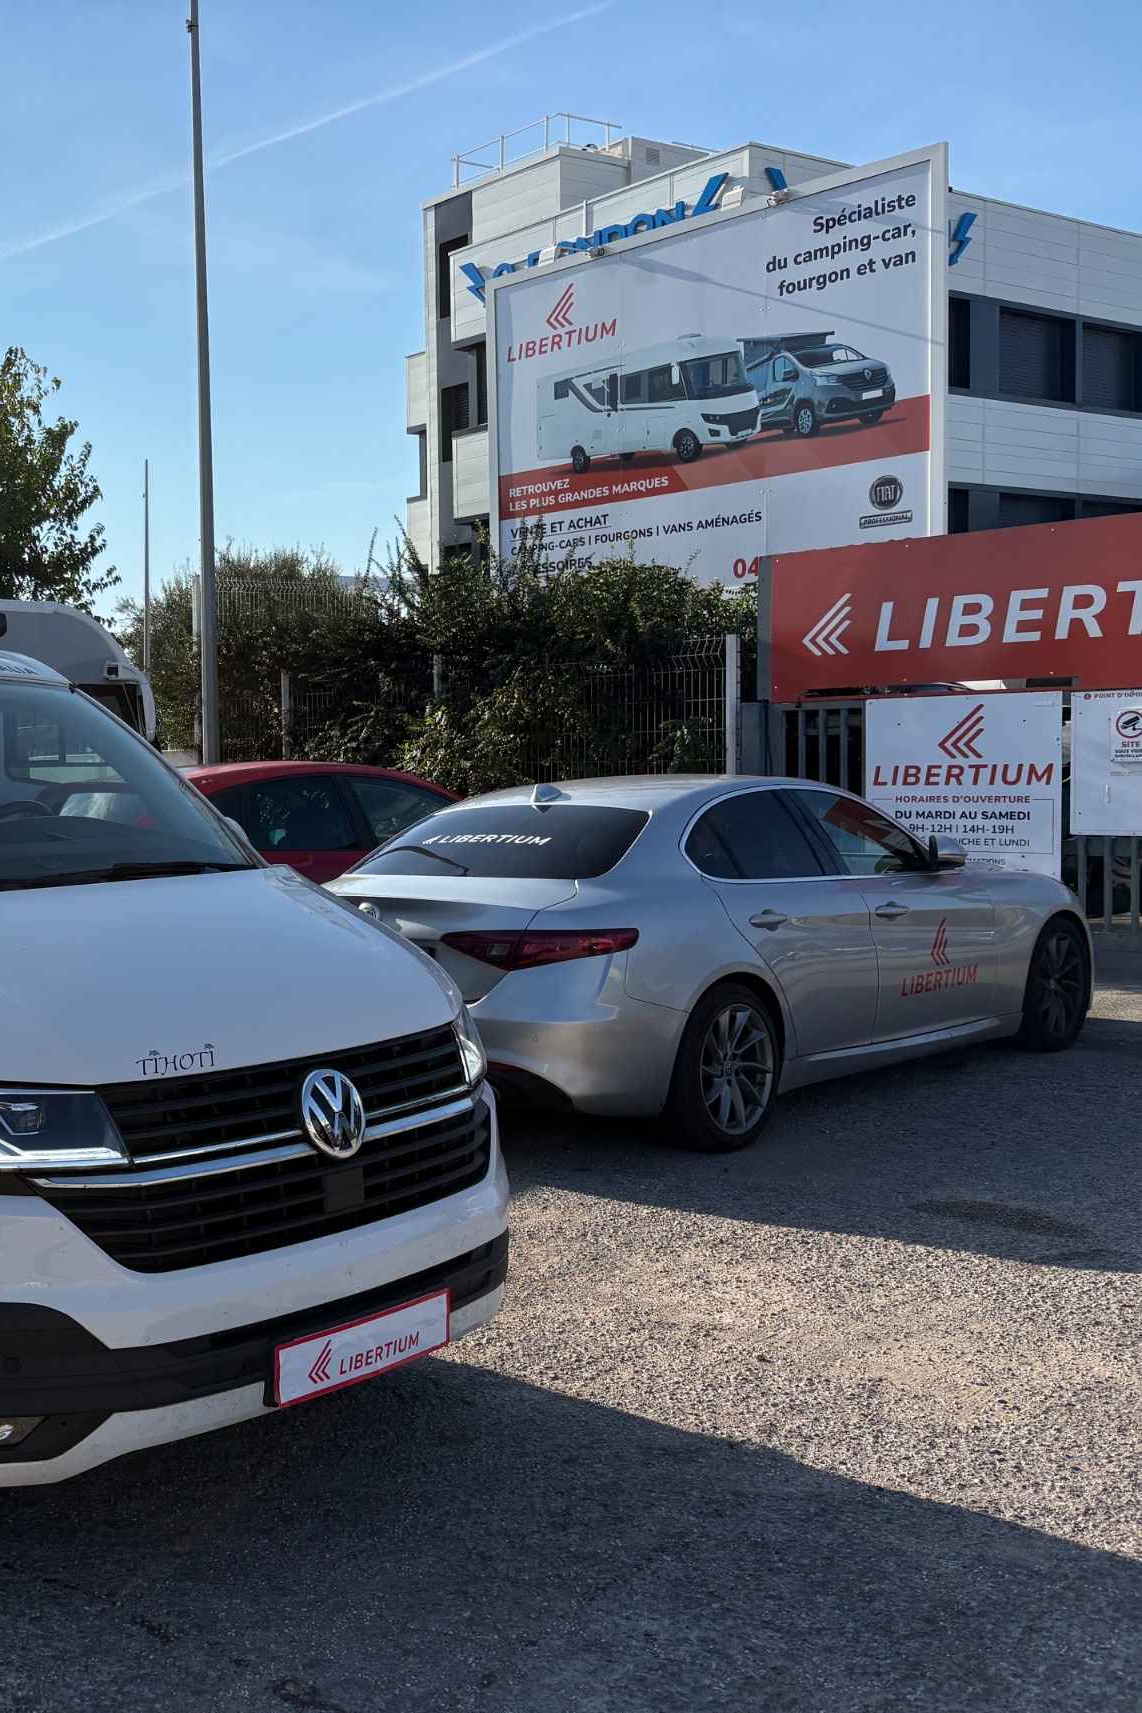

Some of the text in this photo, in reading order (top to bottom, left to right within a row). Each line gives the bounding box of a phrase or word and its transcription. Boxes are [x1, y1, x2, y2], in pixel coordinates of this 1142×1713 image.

[813, 194, 916, 234] Spécialiste
[766, 222, 916, 273] du camping-car,
[778, 250, 916, 296] fourgon et van
[507, 318, 617, 363] LIBERTIUM
[509, 479, 570, 498] RETROUVEZ
[509, 476, 669, 512] LES PLUS GRANDES MARQUES
[876, 485, 896, 502] FIAT
[511, 514, 609, 539] VENE ET ACHAT
[595, 528, 653, 544] FOURGONS
[663, 521, 693, 535] VANS
[696, 509, 762, 530] AMÉNAGÉS
[863, 514, 910, 525] PROFESSIONAL
[873, 763, 1054, 786] LIBERTIUM
[952, 795, 1031, 804] D'OUVERTURE
[895, 810, 1030, 820] DU MARDI AU SAMEDI
[438, 834, 552, 846] LIBERTIUM
[909, 823, 952, 833] 9H-12H
[962, 824, 1014, 834] 14H-19H
[984, 838, 996, 846] ET
[999, 839, 1030, 847] LUNDI
[901, 964, 978, 998] LIBERTIUM
[339, 1331, 420, 1375] LIBERTIUM
